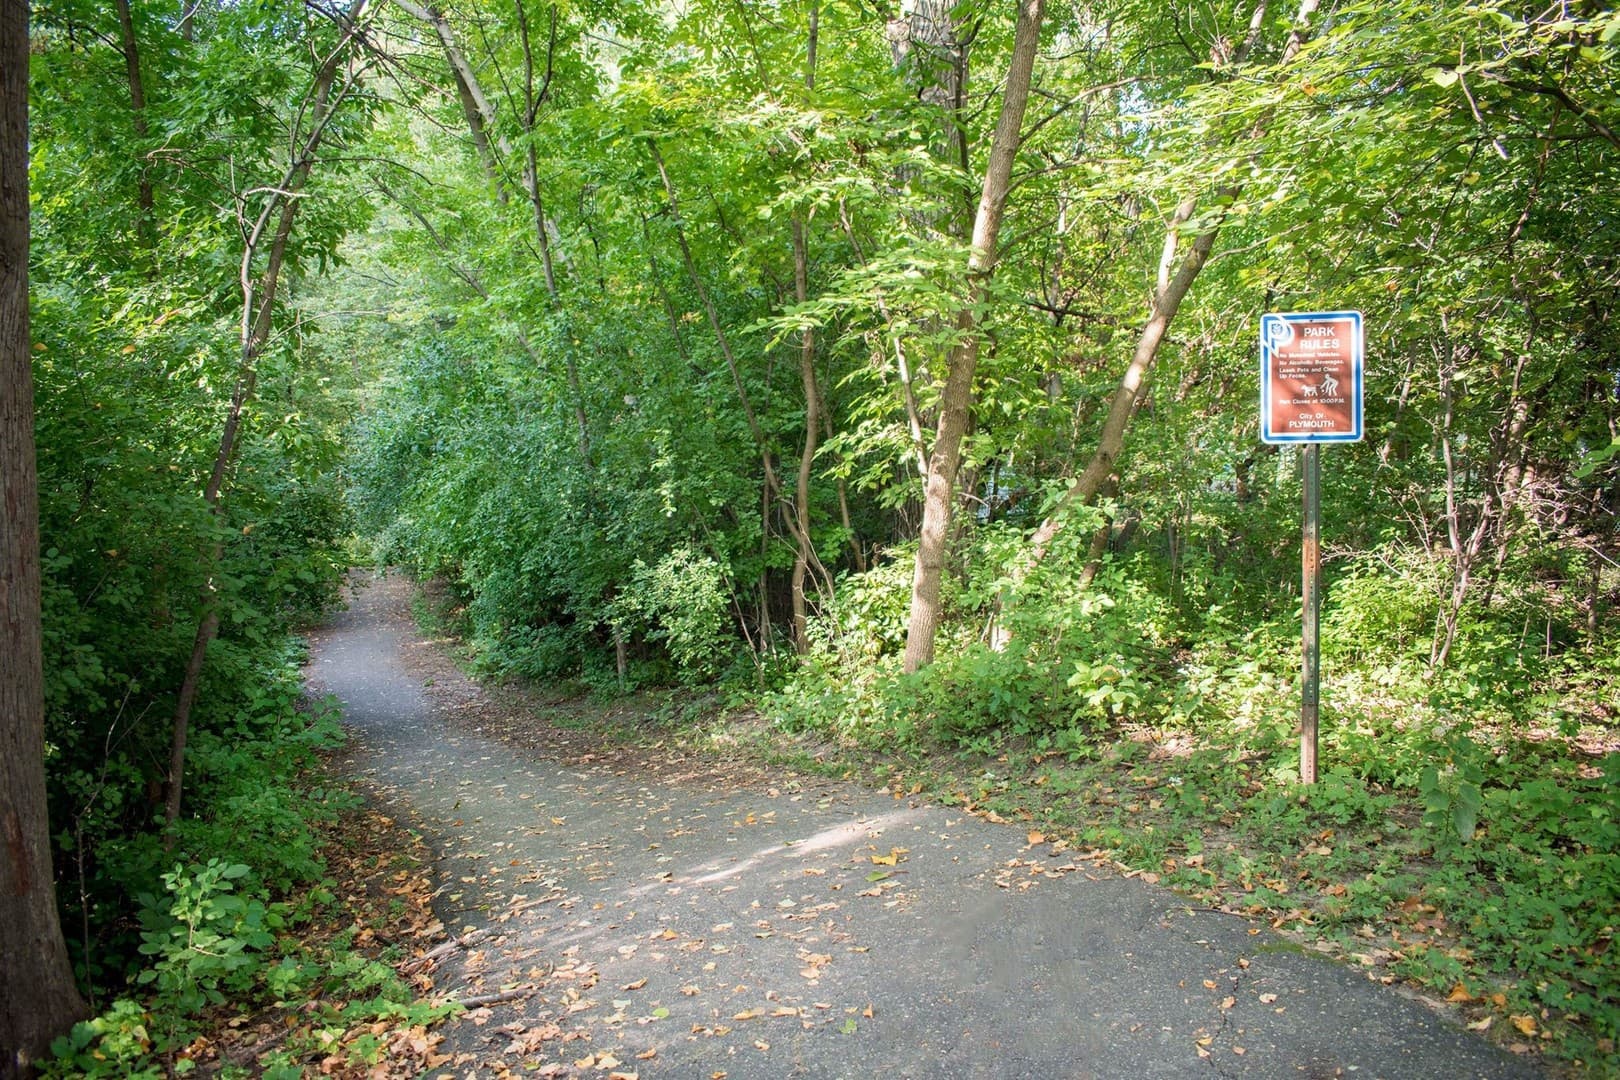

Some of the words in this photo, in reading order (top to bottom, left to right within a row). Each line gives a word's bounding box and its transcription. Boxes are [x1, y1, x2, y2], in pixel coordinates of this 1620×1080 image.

[1304, 327, 1335, 337] PARK
[1300, 338, 1340, 350] RULES
[1299, 412, 1313, 420] City
[1289, 420, 1335, 429] PLYMOUTH
